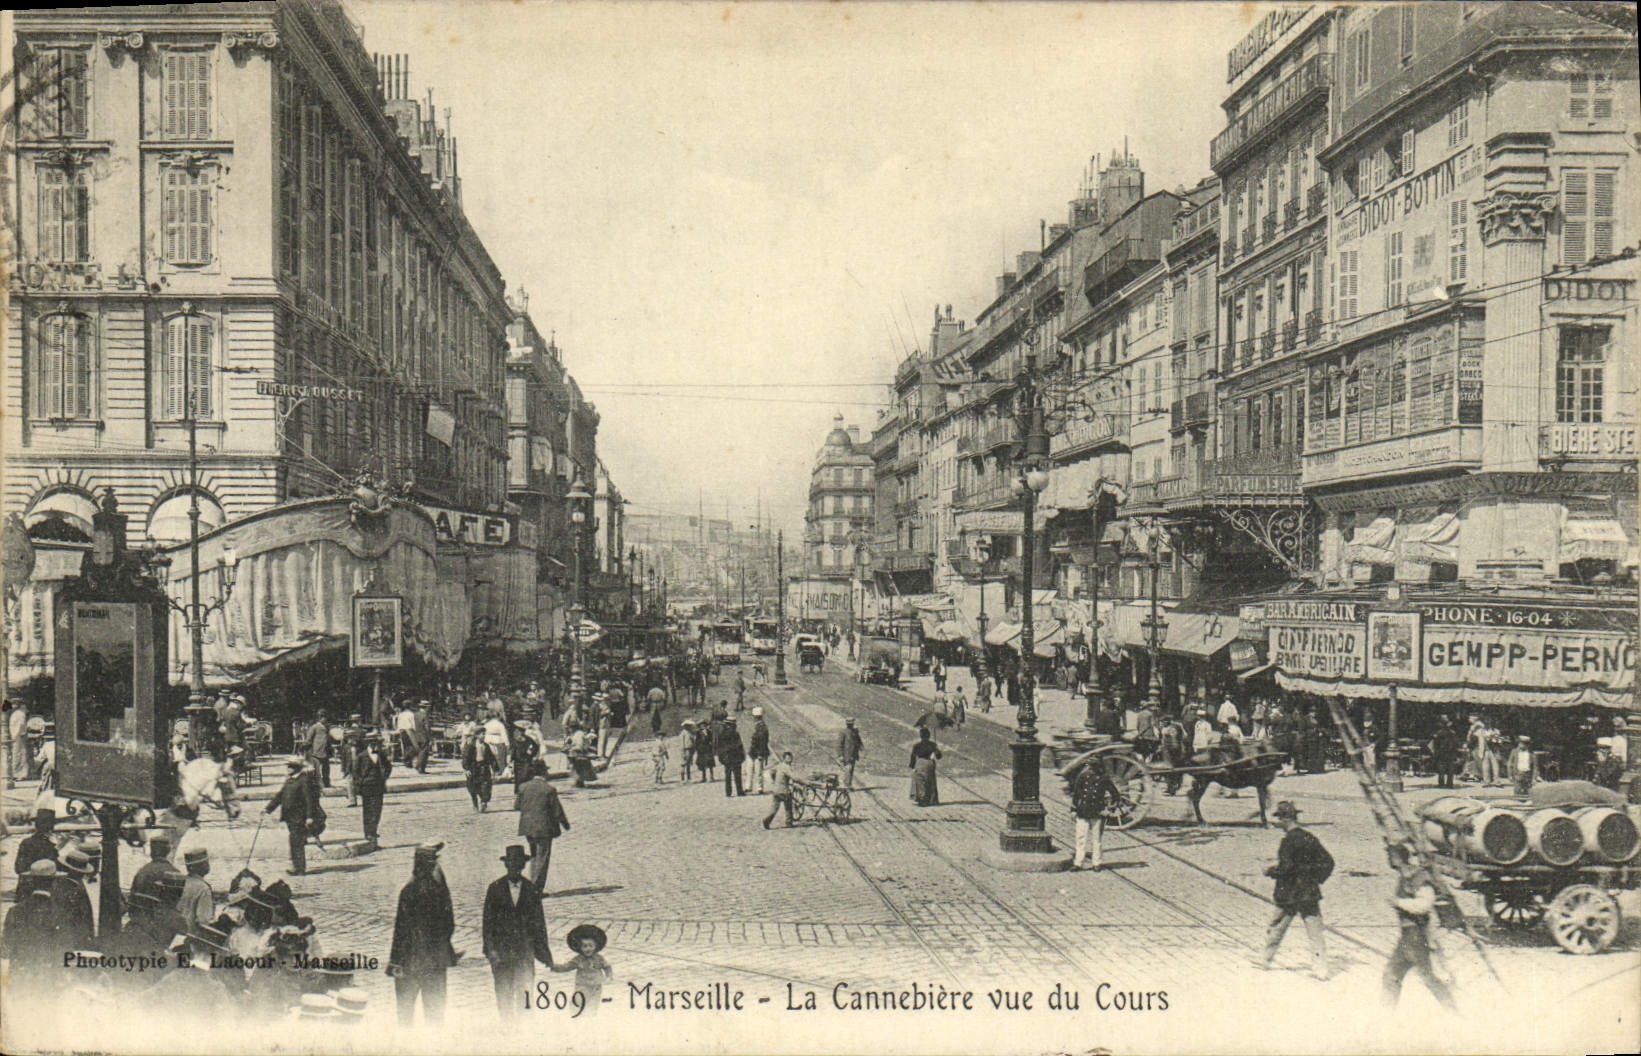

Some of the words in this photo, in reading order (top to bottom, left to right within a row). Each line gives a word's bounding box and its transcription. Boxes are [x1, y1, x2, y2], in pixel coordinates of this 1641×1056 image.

[1360, 188, 1398, 237] DIDOT
[1403, 158, 1455, 215] BOTTIN
[1545, 279, 1636, 301] DIDOT
[1606, 429, 1639, 454] STE
[436, 511, 504, 542] AFE
[1266, 602, 1287, 620] BAR
[1288, 602, 1356, 621] AMERICAIN
[1506, 610, 1553, 626] 16-04
